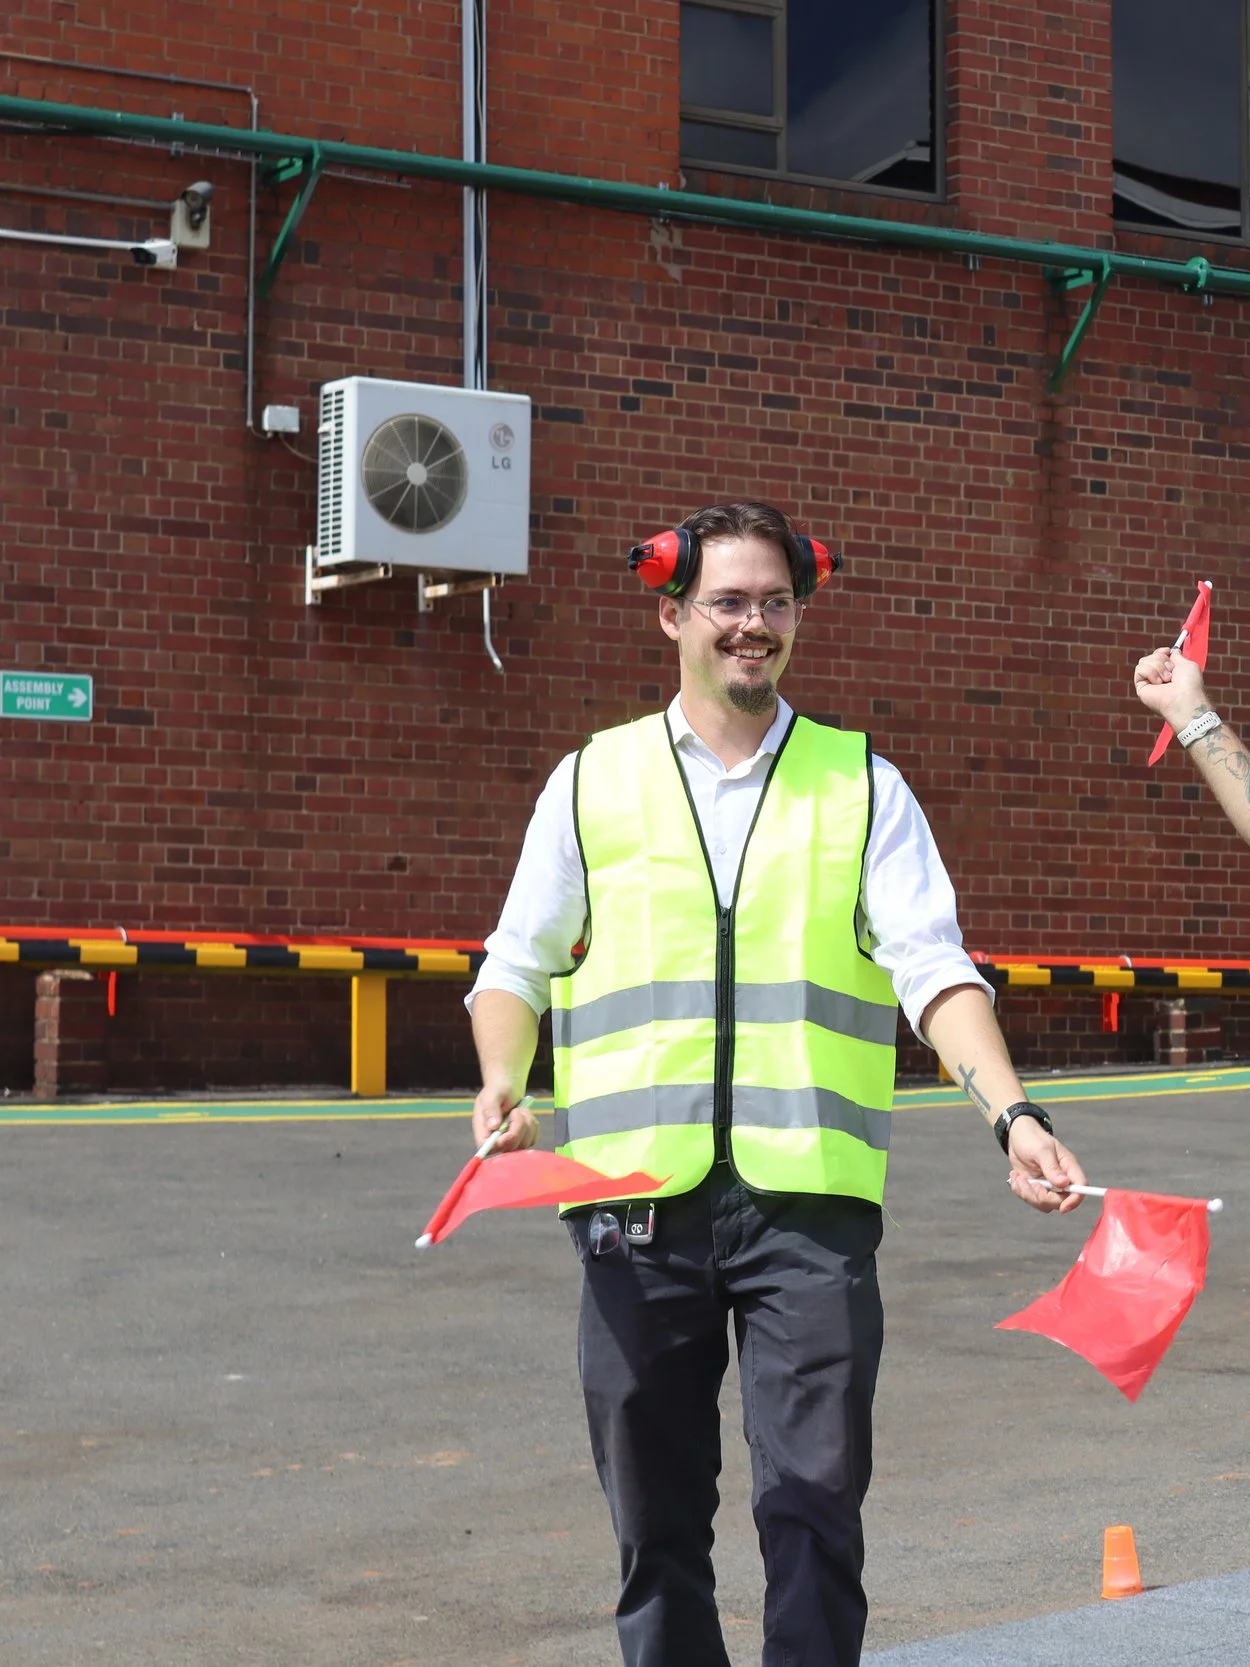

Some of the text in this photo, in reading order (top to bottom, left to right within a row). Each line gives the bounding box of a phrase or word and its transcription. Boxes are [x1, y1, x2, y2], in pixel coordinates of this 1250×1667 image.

[491, 455, 512, 470] LG
[4, 679, 65, 696] ASSEMBLY
[16, 696, 52, 712] POINT
